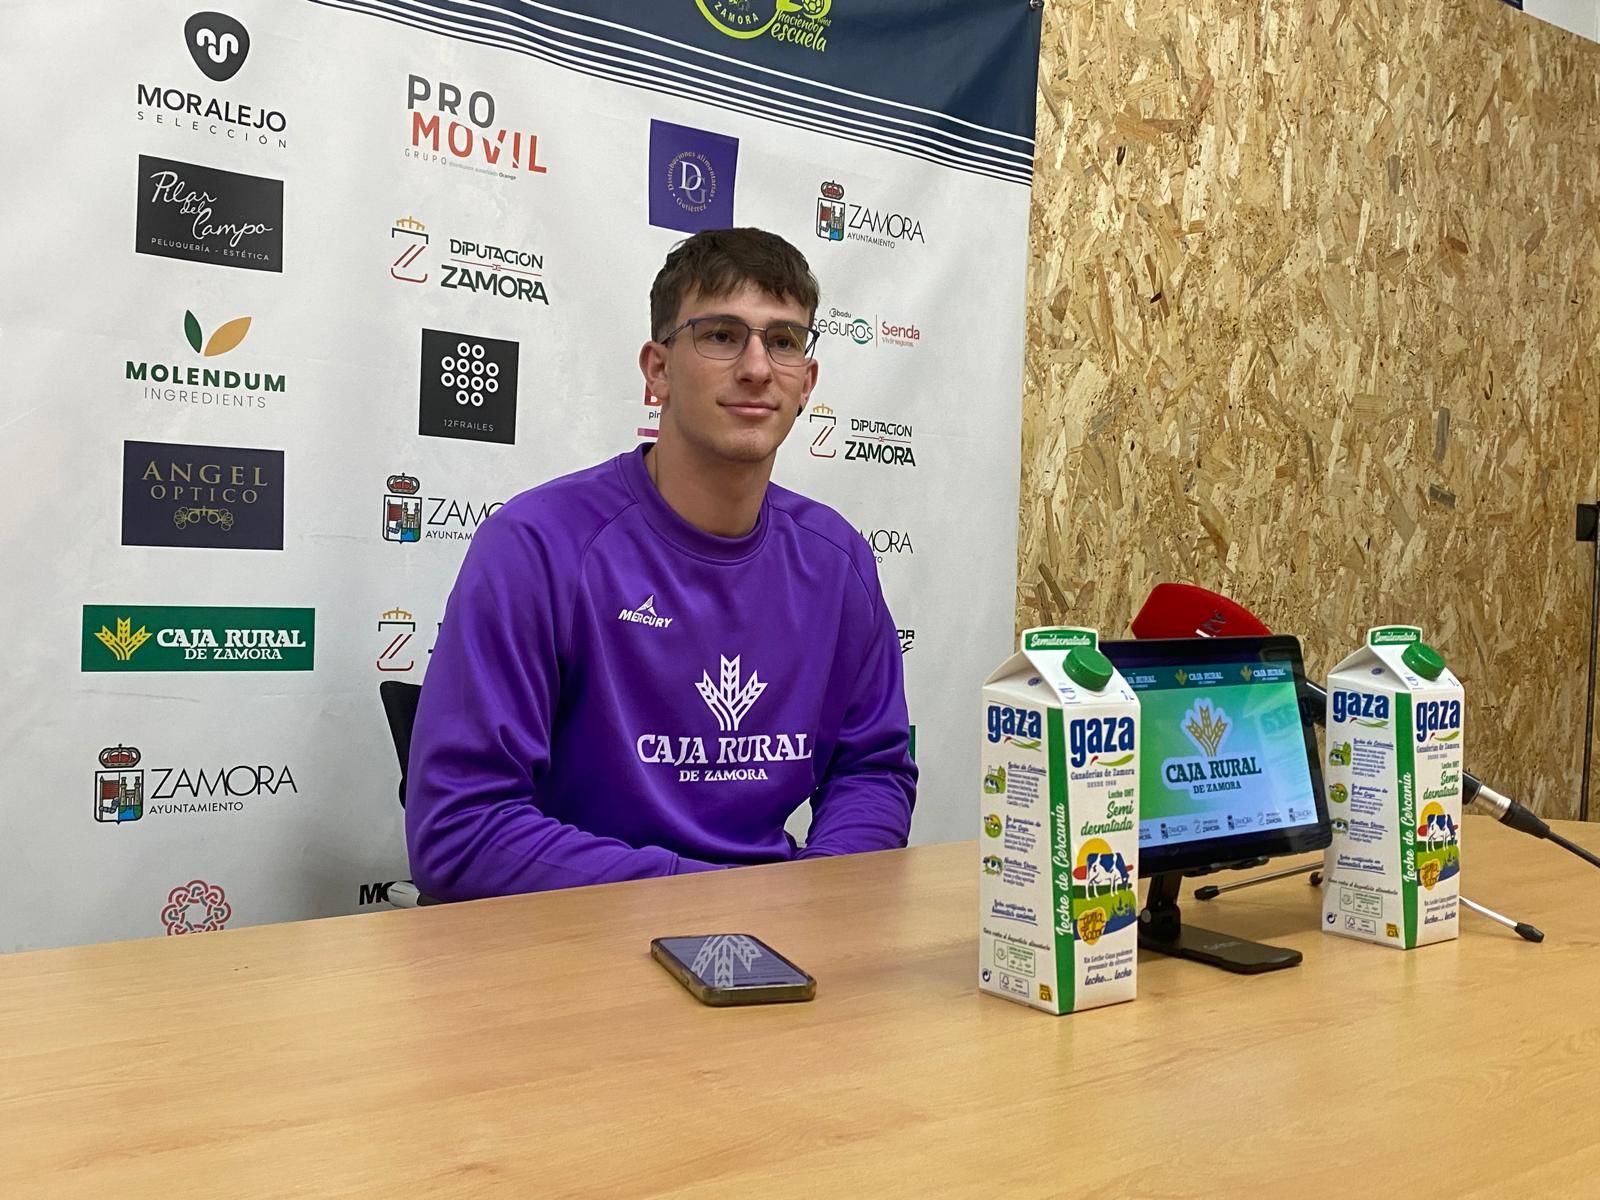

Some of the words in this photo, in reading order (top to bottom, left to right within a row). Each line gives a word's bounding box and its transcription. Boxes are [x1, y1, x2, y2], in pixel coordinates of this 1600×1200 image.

[714, 2, 759, 25] ZAMORA
[778, 10, 819, 33] haciendo
[771, 23, 827, 52] escuela
[137, 84, 287, 132] MORALEJO
[407, 74, 495, 129] PRO
[137, 111, 287, 148] SELECCIÓN
[412, 111, 547, 174] MOVIL
[404, 148, 447, 165] GRUPO
[150, 170, 217, 203] Pilar
[179, 200, 206, 215] del
[192, 207, 273, 247] Campo
[848, 203, 925, 244] ZAMORA
[151, 237, 210, 253] PELUQUERÍA
[223, 248, 270, 261] ESTÉTICA
[847, 231, 896, 249] AYUNTAMIENTO
[440, 263, 550, 306] ZAMORA
[882, 321, 920, 341] Senda
[125, 360, 286, 393] MOLENDUM
[144, 386, 267, 409] INGREDIENTS
[443, 418, 495, 432] 12FRAILES
[844, 440, 917, 467] ZAMORA
[141, 460, 268, 487] ANGEL
[150, 483, 258, 504] OPTICO
[425, 530, 472, 541] AYUNTAM
[618, 609, 673, 628] MERCURY
[156, 628, 218, 649] CAJA
[224, 629, 307, 648] RURAL
[184, 648, 208, 660] DE
[213, 648, 283, 660] ZAMORA
[1333, 691, 1389, 723] gaza
[987, 705, 1042, 744] gaza
[1416, 700, 1461, 743] gaza
[636, 733, 709, 766] CAJA
[715, 733, 812, 765] RURAL
[1069, 716, 1135, 768] gaza
[678, 770, 700, 783] DE
[704, 768, 769, 782] ZAMORA
[1113, 768, 1135, 776] Zamora
[1166, 763, 1208, 784] CAJA
[1210, 757, 1262, 779] RURAL
[1441, 770, 1459, 786] Semi
[151, 765, 298, 800] ZAMORA
[1193, 783, 1204, 794] DE
[1206, 781, 1242, 793] ZAMORA
[149, 801, 244, 815] AYUNTAMIENTO
[1106, 800, 1134, 819] Semi
[1080, 819, 1133, 836] desnatada
[1055, 872, 1069, 891] de
[1114, 968, 1132, 981] leche
